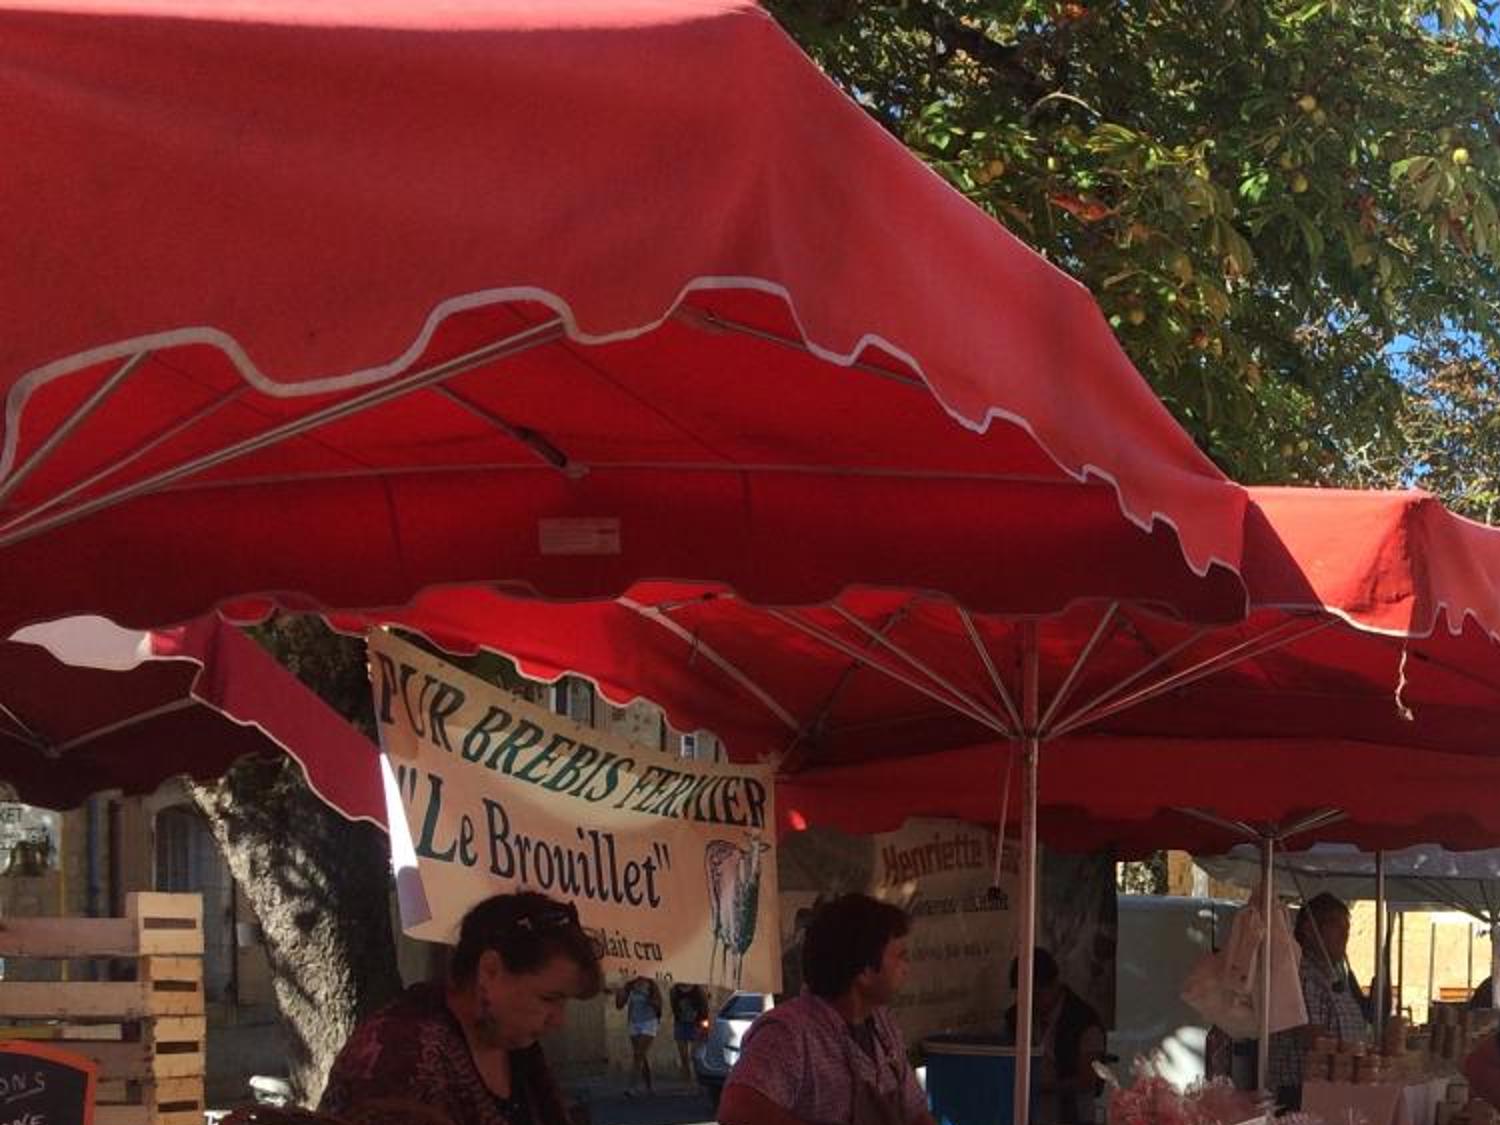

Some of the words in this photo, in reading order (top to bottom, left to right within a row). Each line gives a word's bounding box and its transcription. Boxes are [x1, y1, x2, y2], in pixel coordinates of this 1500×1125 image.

[376, 650, 465, 753] PUR
[461, 704, 636, 802] BREBIS
[613, 765, 767, 830] FERMIER
[481, 796, 672, 909] Brouillet"
[882, 831, 984, 885] Henriette
[633, 940, 663, 963] cru
